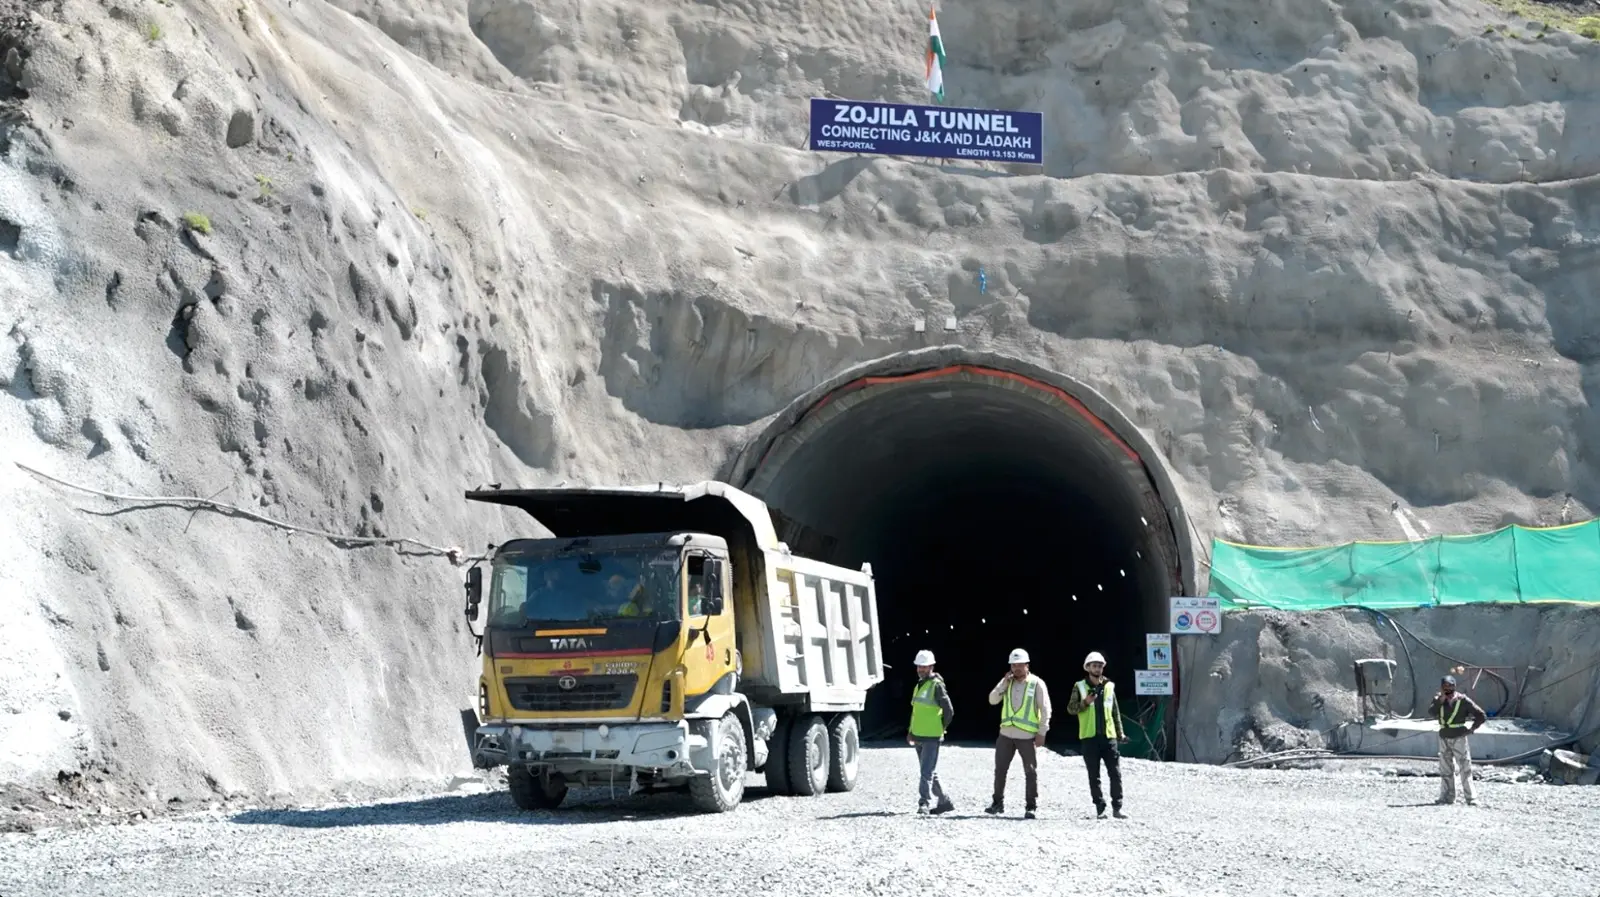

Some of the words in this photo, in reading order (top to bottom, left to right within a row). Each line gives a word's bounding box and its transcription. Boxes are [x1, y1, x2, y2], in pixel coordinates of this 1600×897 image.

[834, 104, 919, 127] ZOJILA
[924, 110, 1019, 133] TUNNEL
[821, 124, 911, 142] CONNECTING
[914, 130, 941, 144] J&K
[943, 132, 973, 146] AND
[976, 134, 1032, 149] LADAKH
[817, 139, 876, 150] WEST-PORTAL
[956, 148, 990, 157] LENGTH
[991, 149, 1017, 159] 13.153
[1017, 151, 1036, 160] Kms
[550, 638, 587, 650] TATA
